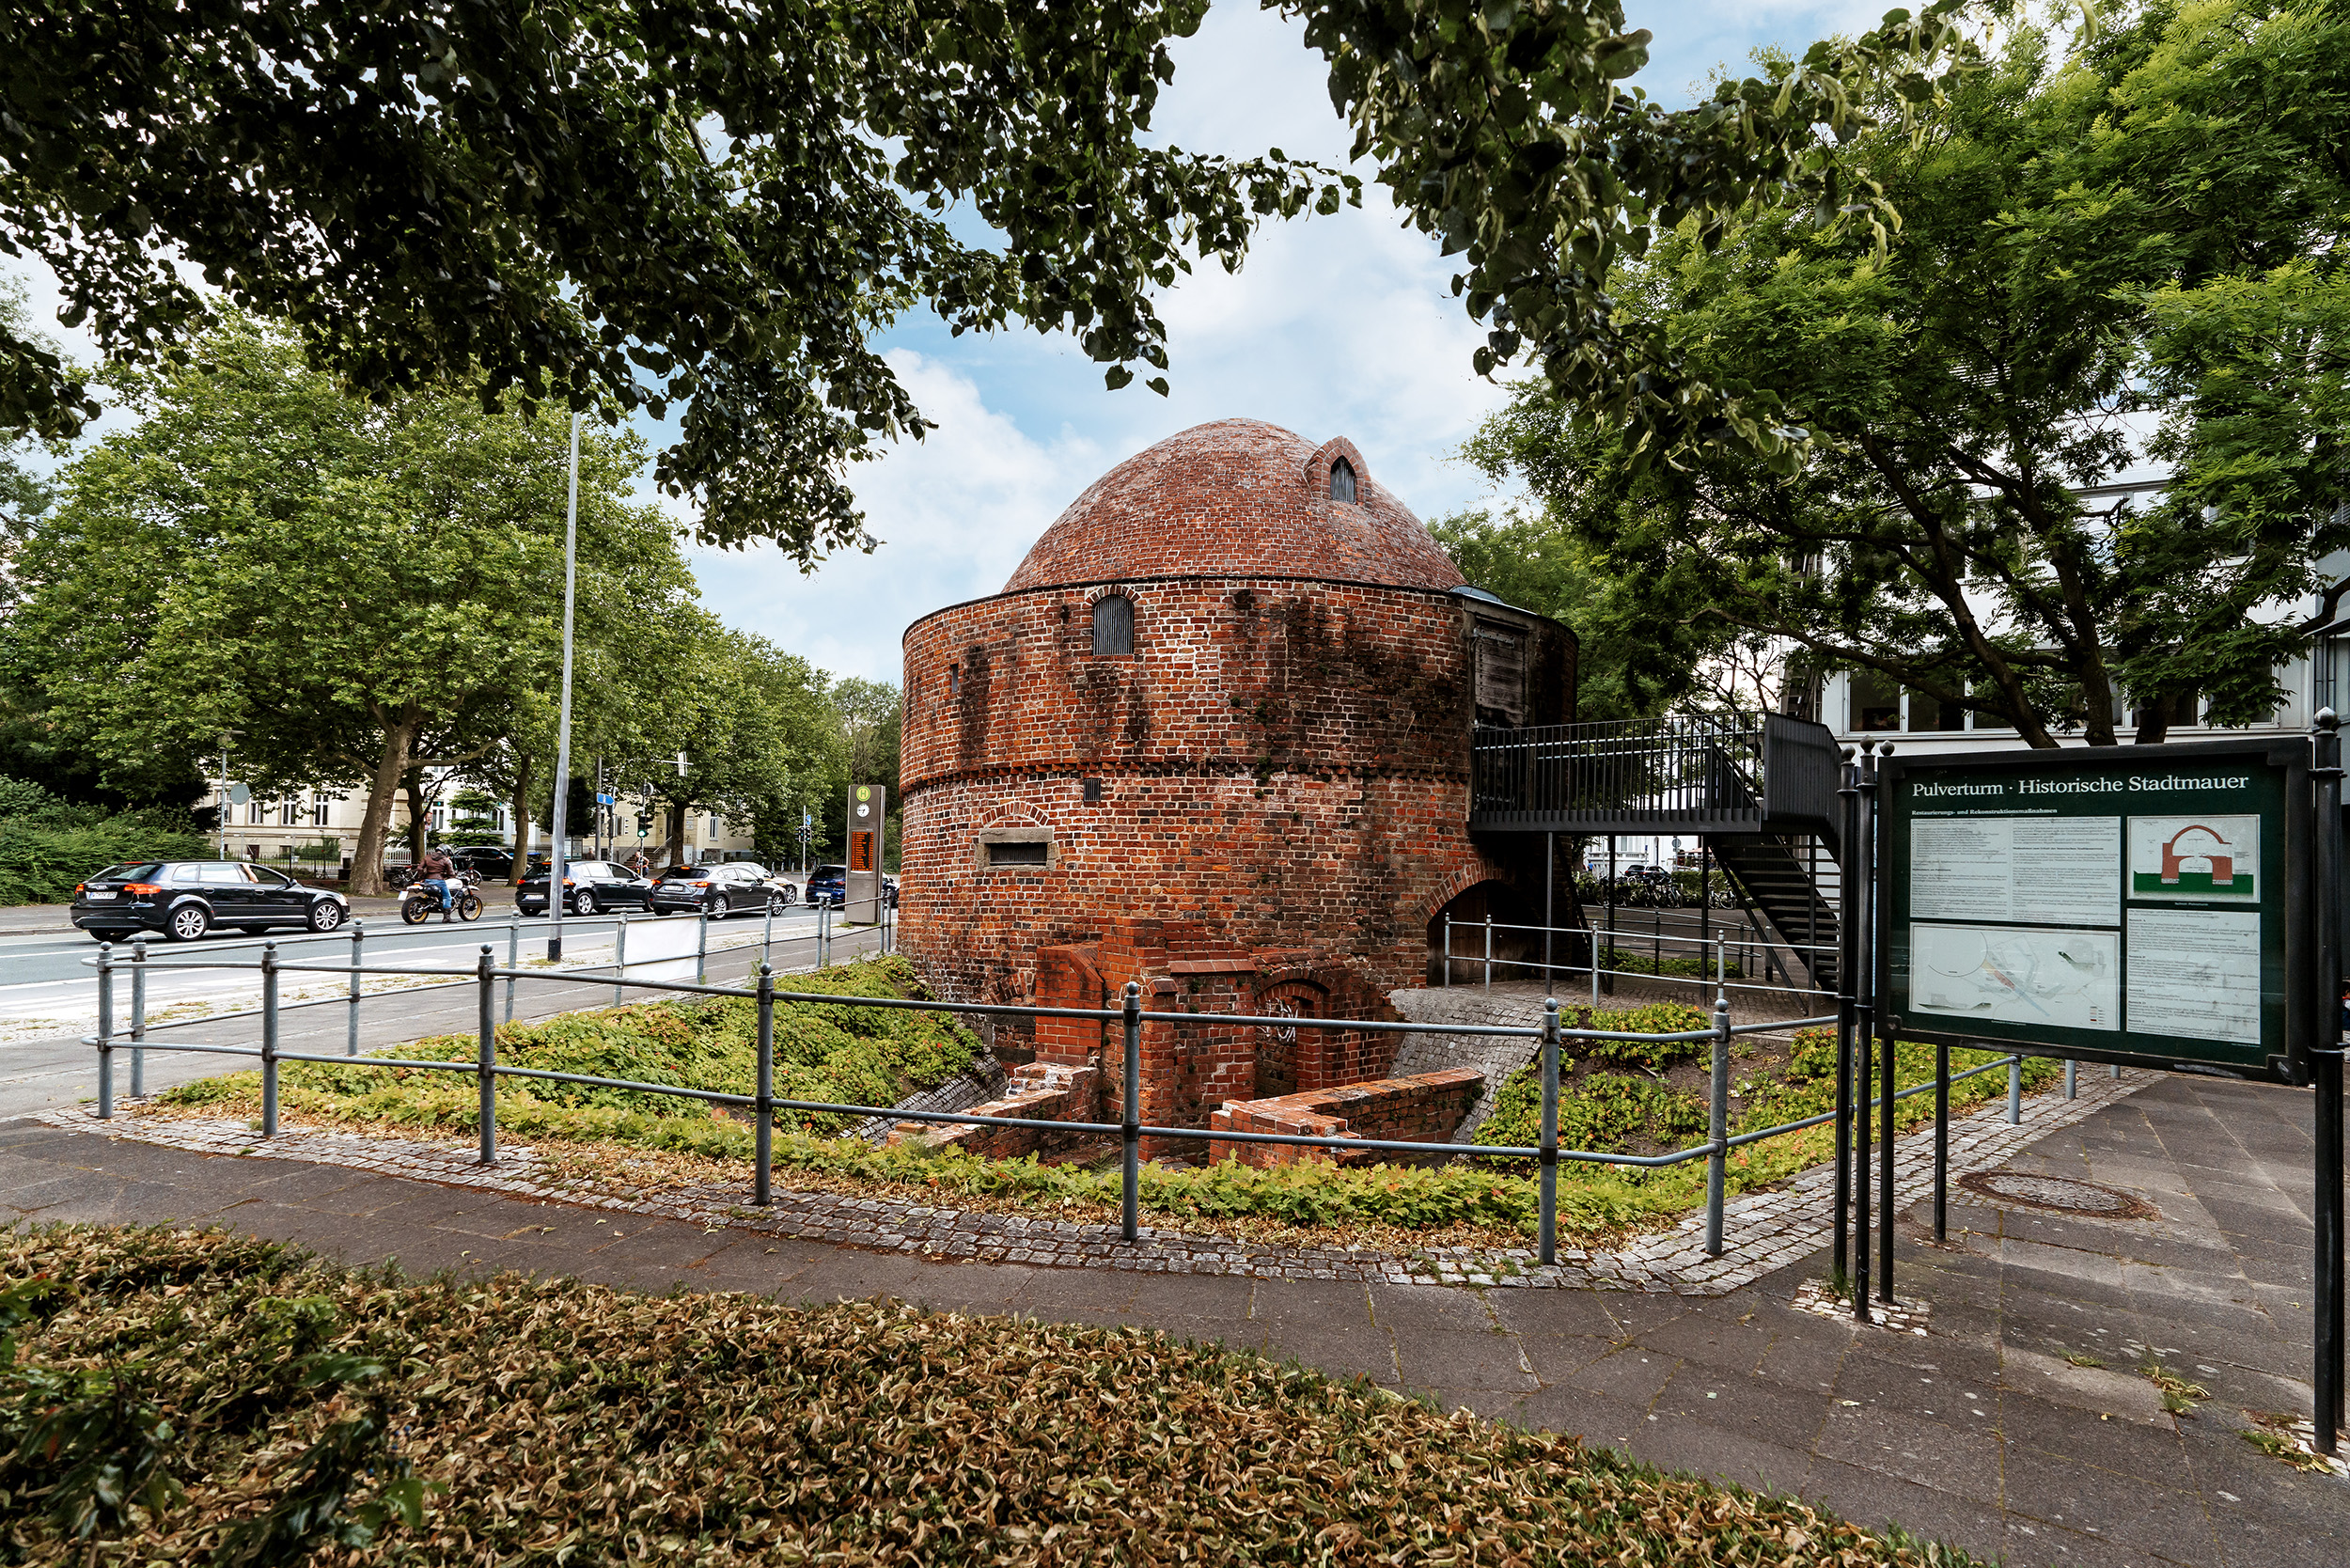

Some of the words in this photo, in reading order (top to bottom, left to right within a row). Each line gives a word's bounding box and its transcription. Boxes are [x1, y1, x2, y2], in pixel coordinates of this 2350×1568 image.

[1912, 783, 2004, 796] Pulverturm
[2018, 777, 2123, 793] Historische
[2128, 775, 2249, 791] Stadtmauer
[860, 790, 867, 798] H
